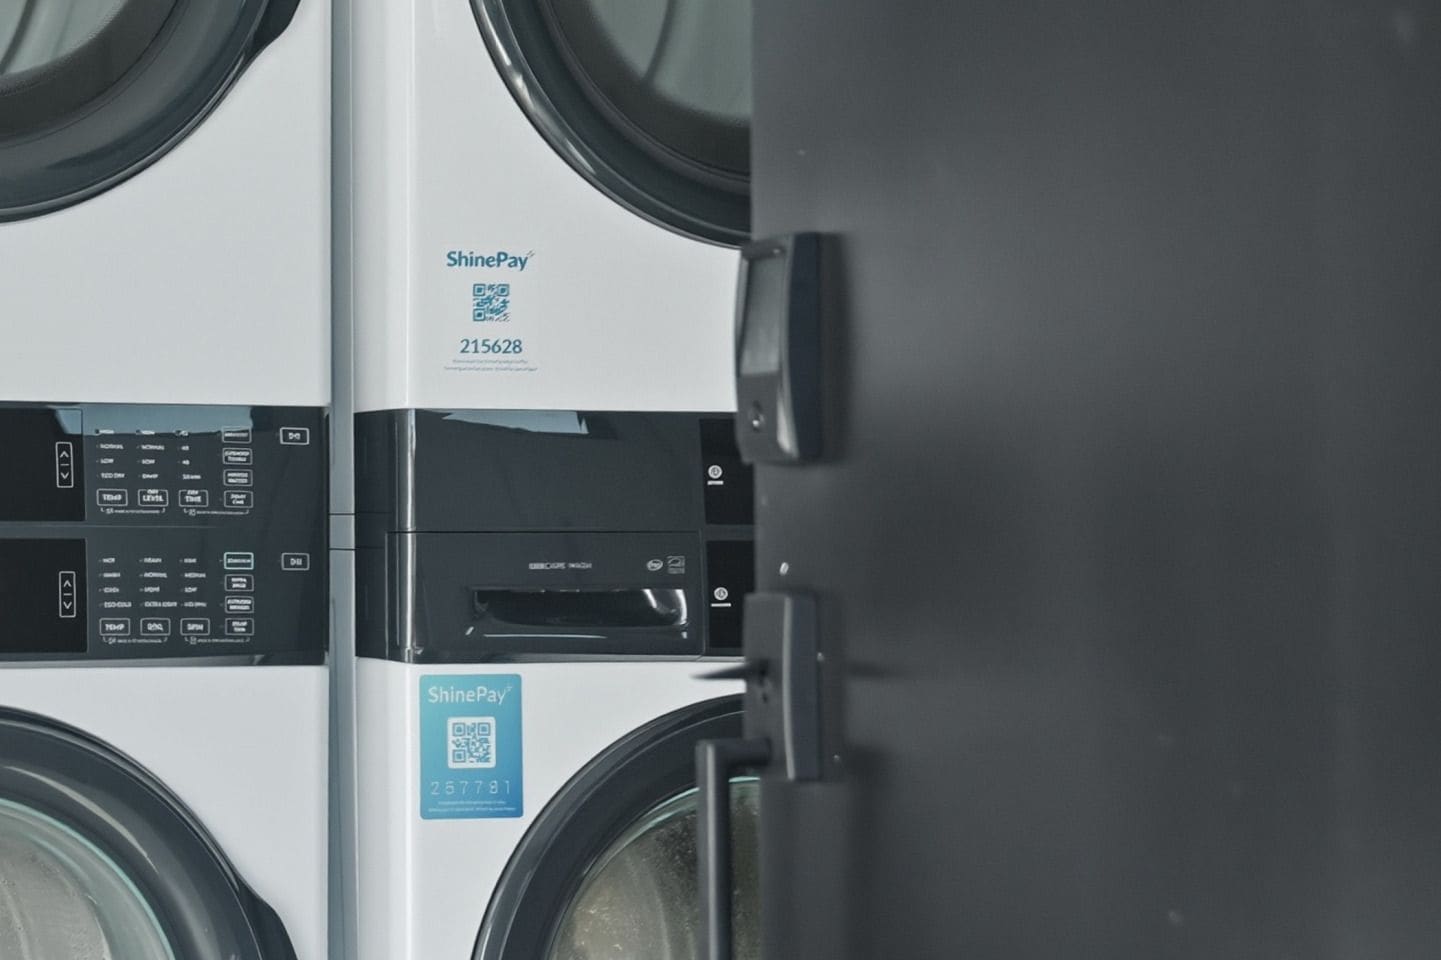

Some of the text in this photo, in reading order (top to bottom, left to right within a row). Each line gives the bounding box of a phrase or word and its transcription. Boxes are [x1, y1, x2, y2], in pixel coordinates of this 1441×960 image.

[445, 250, 529, 272] ShinePay
[459, 338, 524, 355] 215628
[427, 685, 507, 705] ShinePay
